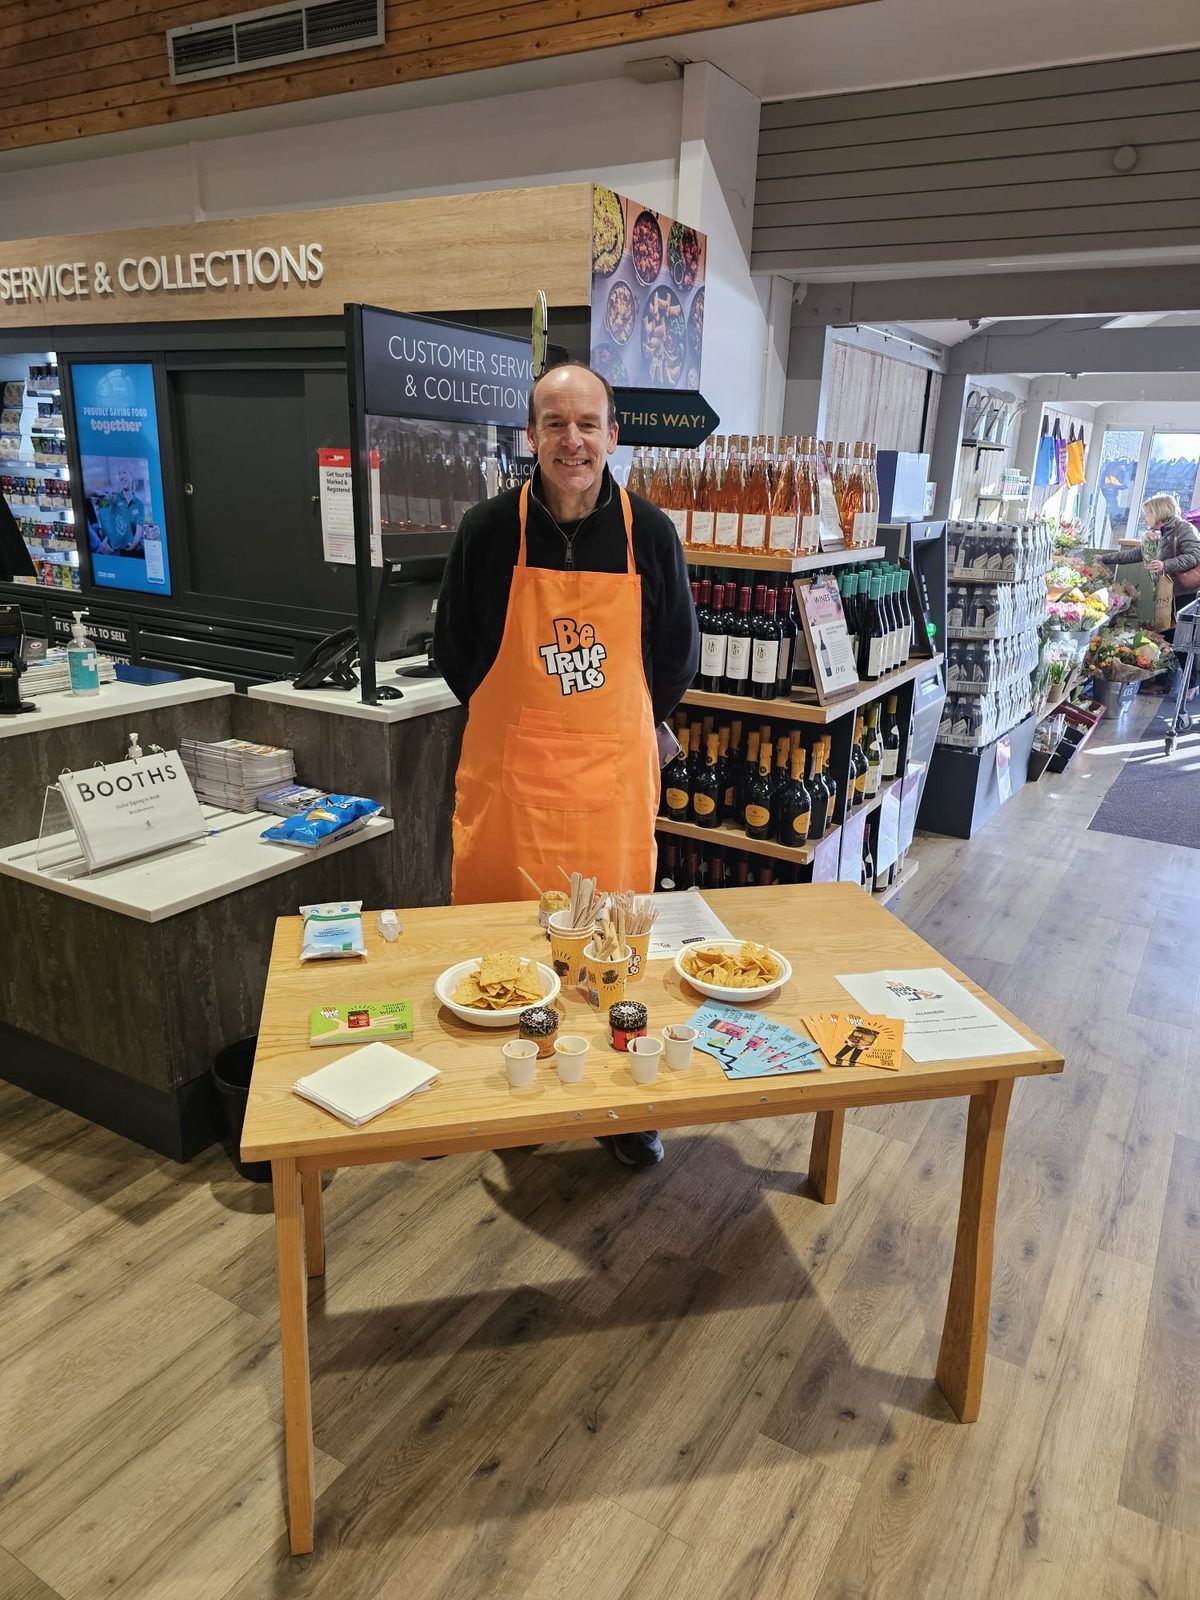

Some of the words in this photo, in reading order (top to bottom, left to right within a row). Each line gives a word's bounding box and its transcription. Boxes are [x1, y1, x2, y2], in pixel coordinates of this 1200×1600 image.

[0, 262, 88, 300] SERVICE
[94, 261, 113, 293] &
[118, 243, 324, 291] COLLECTIONS
[388, 335, 486, 374] CUSTOMER
[404, 374, 417, 397] &
[424, 376, 528, 410] COLLECTION
[83, 407, 108, 416] PROUDLY
[110, 408, 130, 417] SAVING
[132, 408, 148, 417] FOOD
[620, 412, 657, 426] THIS
[662, 414, 705, 428] WAY!
[90, 418, 142, 435] together
[327, 486, 351, 494] Registered
[814, 594, 831, 604] WINES
[54, 621, 62, 631] IT
[63, 622, 70, 632] IS
[98, 628, 109, 640] TO
[111, 630, 127, 643] SELL
[553, 617, 596, 654] Be
[77, 765, 177, 802] BOOTHS
[115, 801, 129, 810] Visitor
